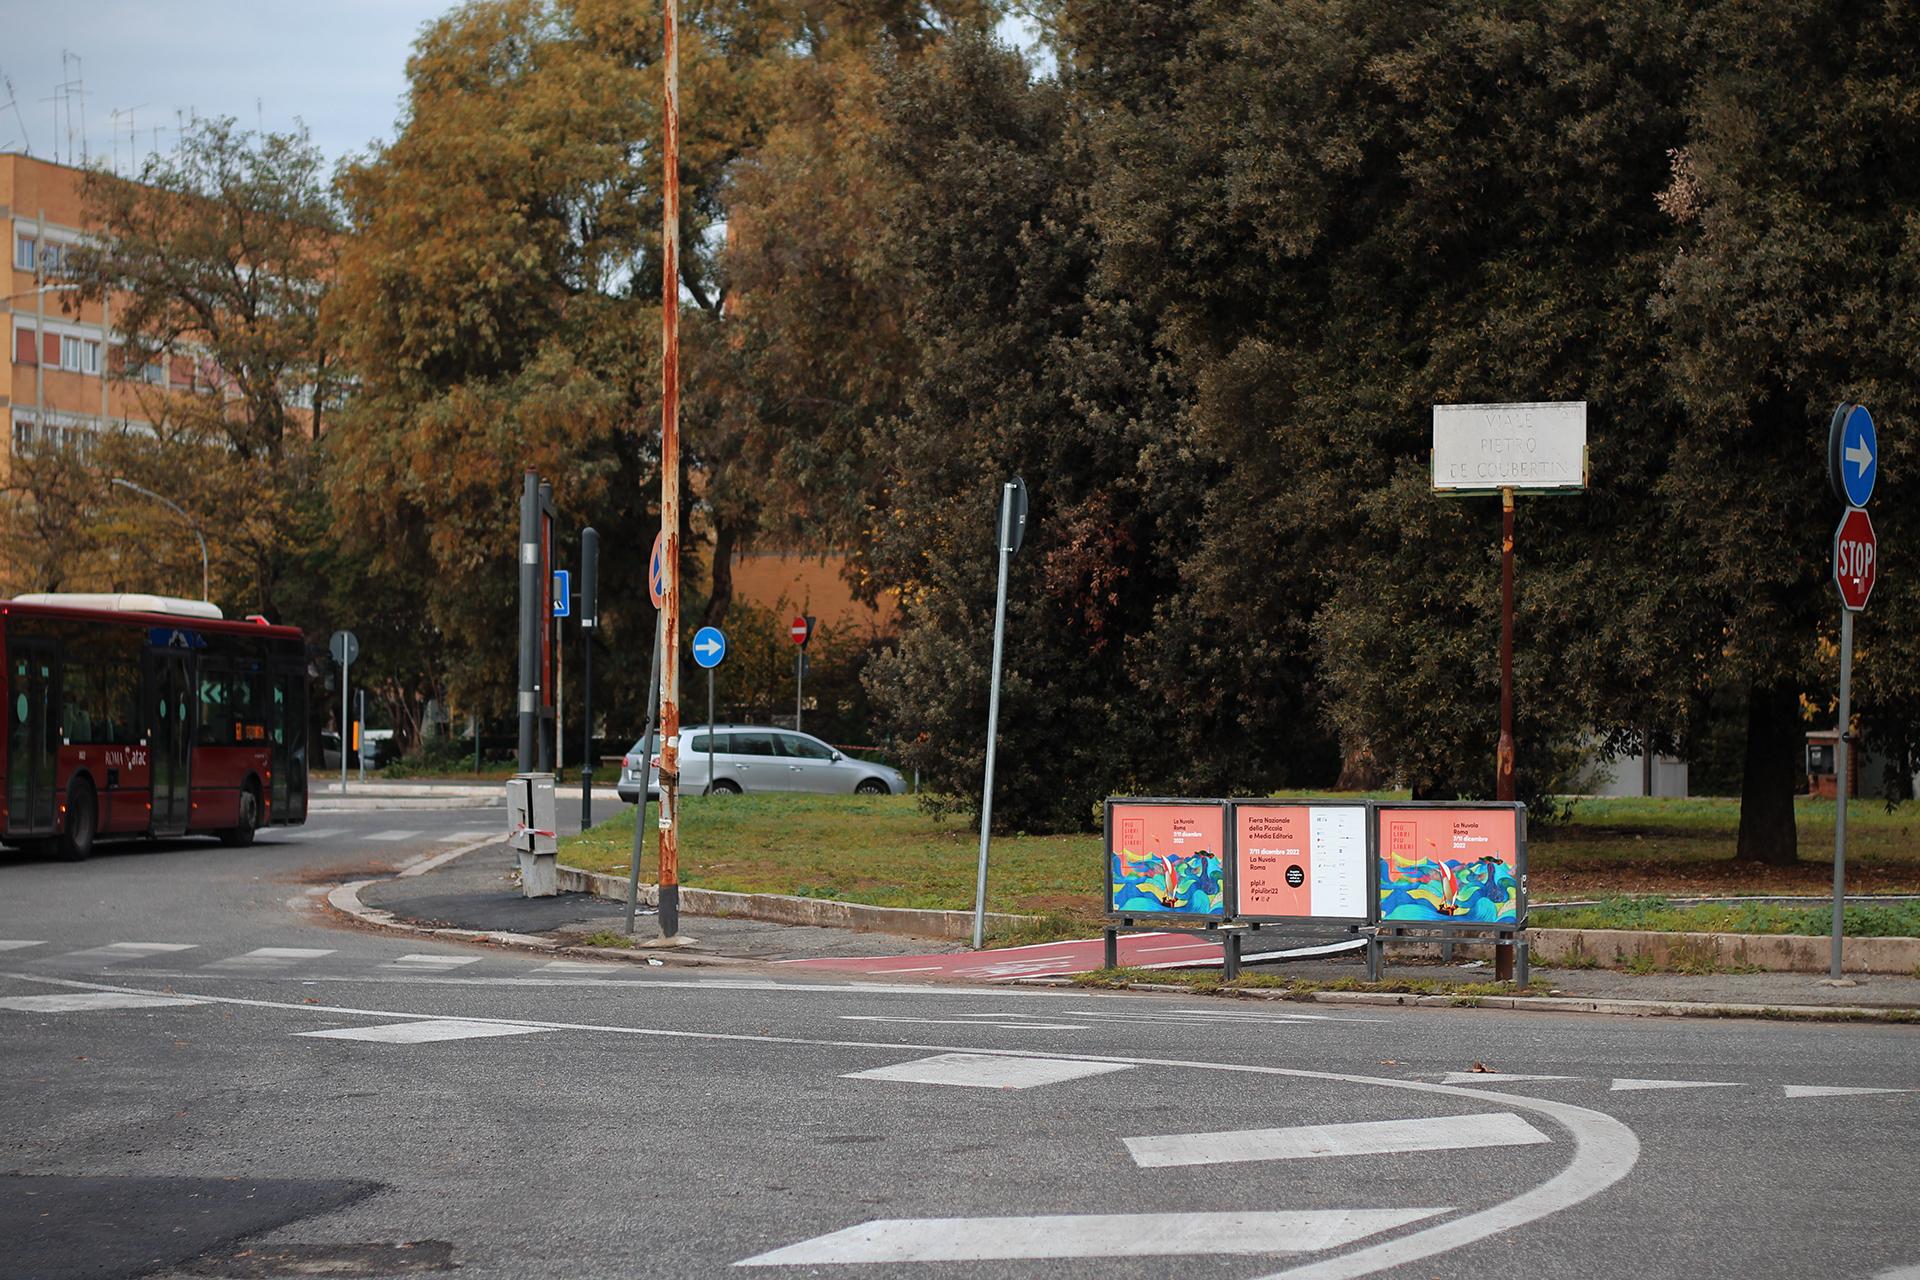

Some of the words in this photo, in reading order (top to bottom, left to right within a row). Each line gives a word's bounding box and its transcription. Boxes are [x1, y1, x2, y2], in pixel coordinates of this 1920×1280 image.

[1485, 413, 1533, 428] VIALE
[1481, 437, 1536, 453] PIETRO
[1450, 463, 1468, 478] DE
[1477, 462, 1568, 478] COUBERTIN
[1840, 540, 1873, 577] STOP
[131, 749, 147, 766] atac
